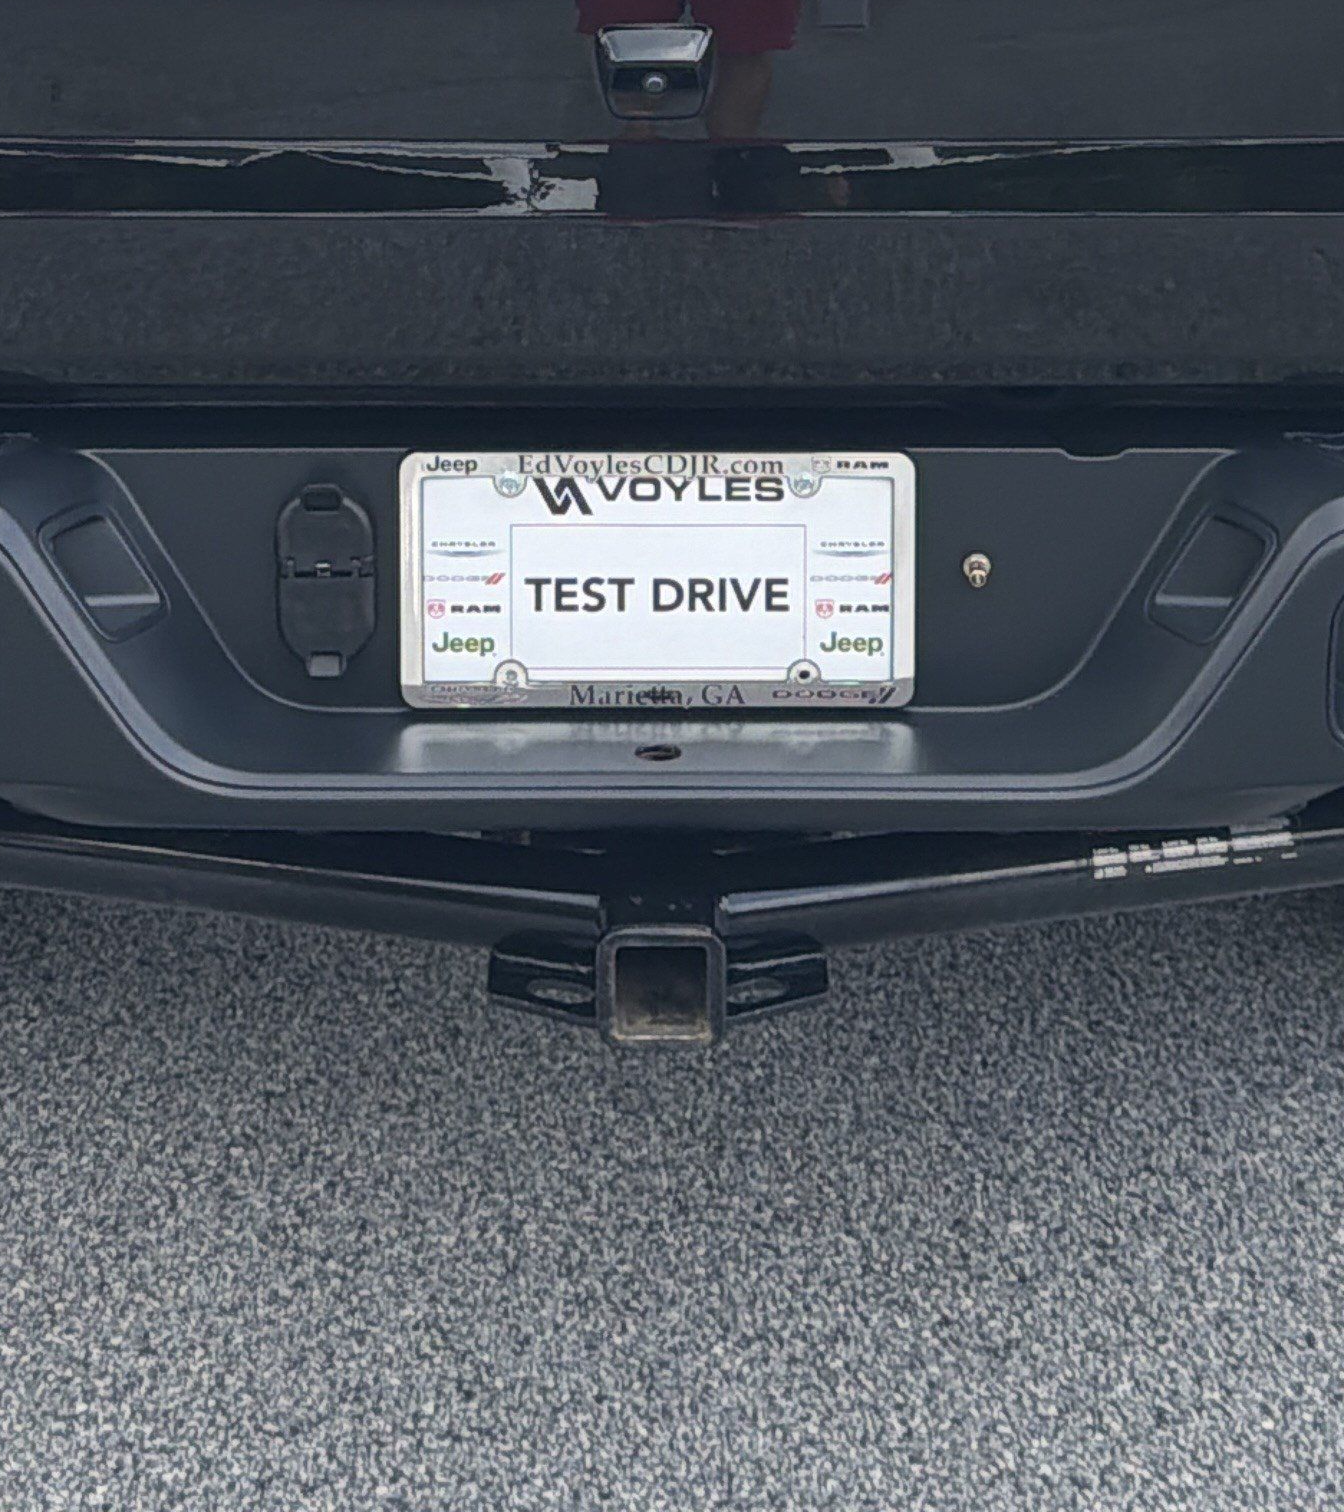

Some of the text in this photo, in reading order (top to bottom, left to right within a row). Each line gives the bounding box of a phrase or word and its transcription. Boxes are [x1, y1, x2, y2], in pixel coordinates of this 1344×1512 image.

[426, 455, 478, 476] Jeep
[518, 454, 784, 482] EdVoylesCDJR.com
[836, 461, 889, 469] RAM
[597, 477, 785, 501] VOYLES
[525, 578, 790, 612] TEST DRIVE
[450, 604, 501, 613] RAM
[839, 604, 890, 613] RAM
[432, 631, 495, 656] Jeep
[819, 631, 884, 656] Jeep
[701, 684, 745, 705] GA
